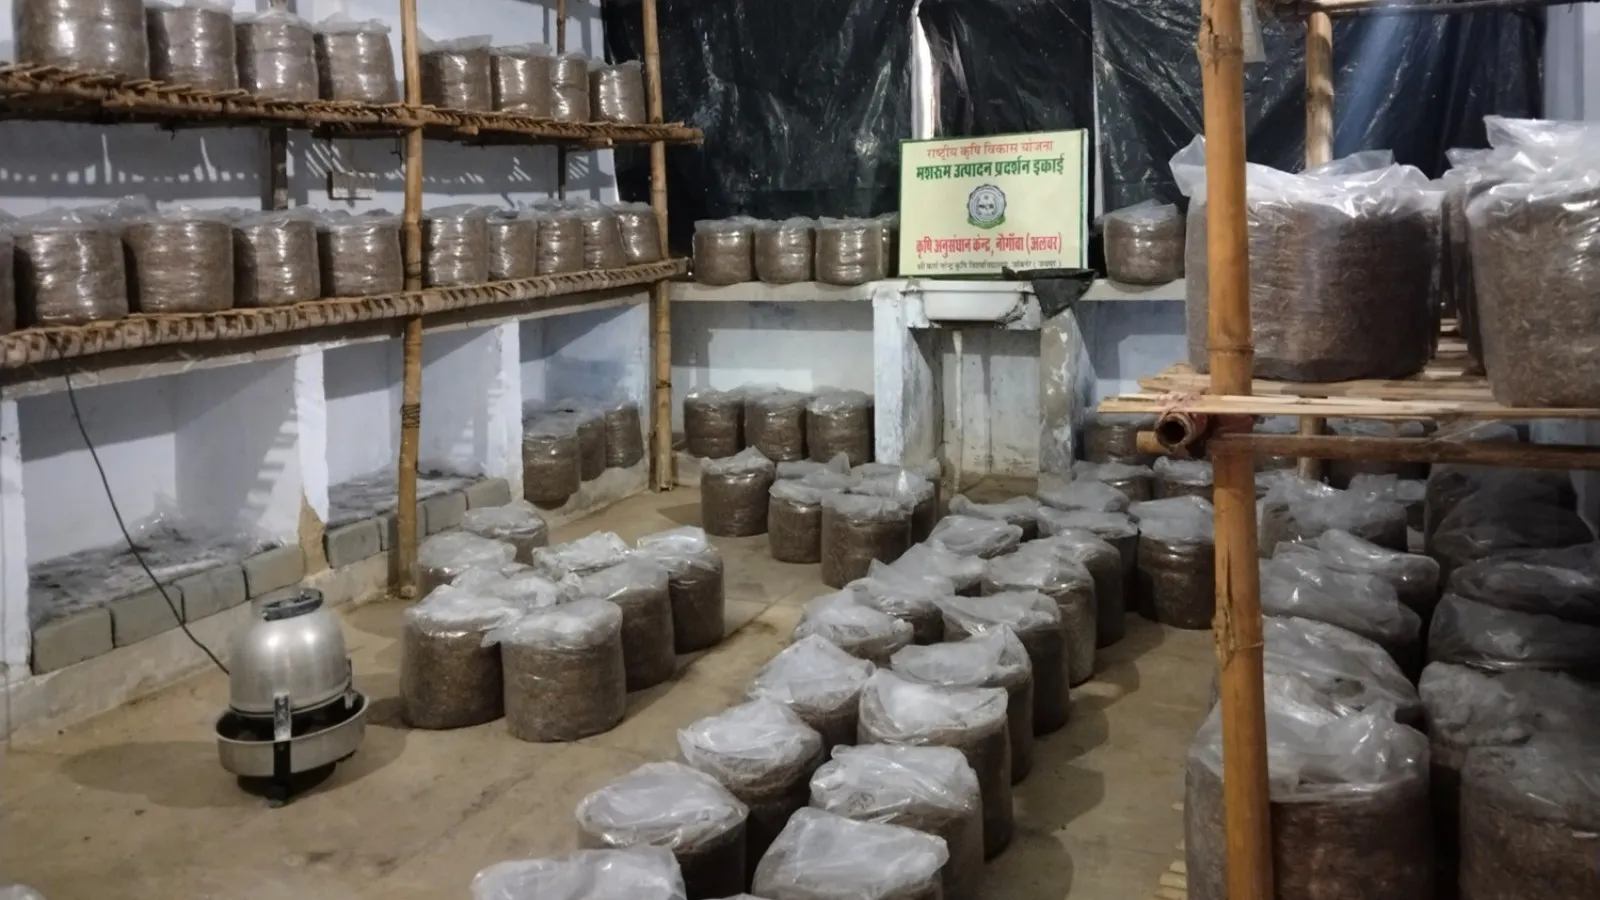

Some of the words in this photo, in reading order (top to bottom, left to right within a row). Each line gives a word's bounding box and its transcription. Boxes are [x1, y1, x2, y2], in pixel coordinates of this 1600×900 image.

[960, 142, 981, 160] कृषि
[984, 141, 1018, 155] विकास
[1021, 138, 1054, 152] योजना
[916, 164, 950, 180] मशरूम
[954, 161, 992, 178] उत्पादन
[994, 156, 1031, 177] प्रदर्शन
[1033, 153, 1065, 176] इकाई
[916, 236, 932, 258] कृषि
[934, 234, 971, 258] अनुसंधान
